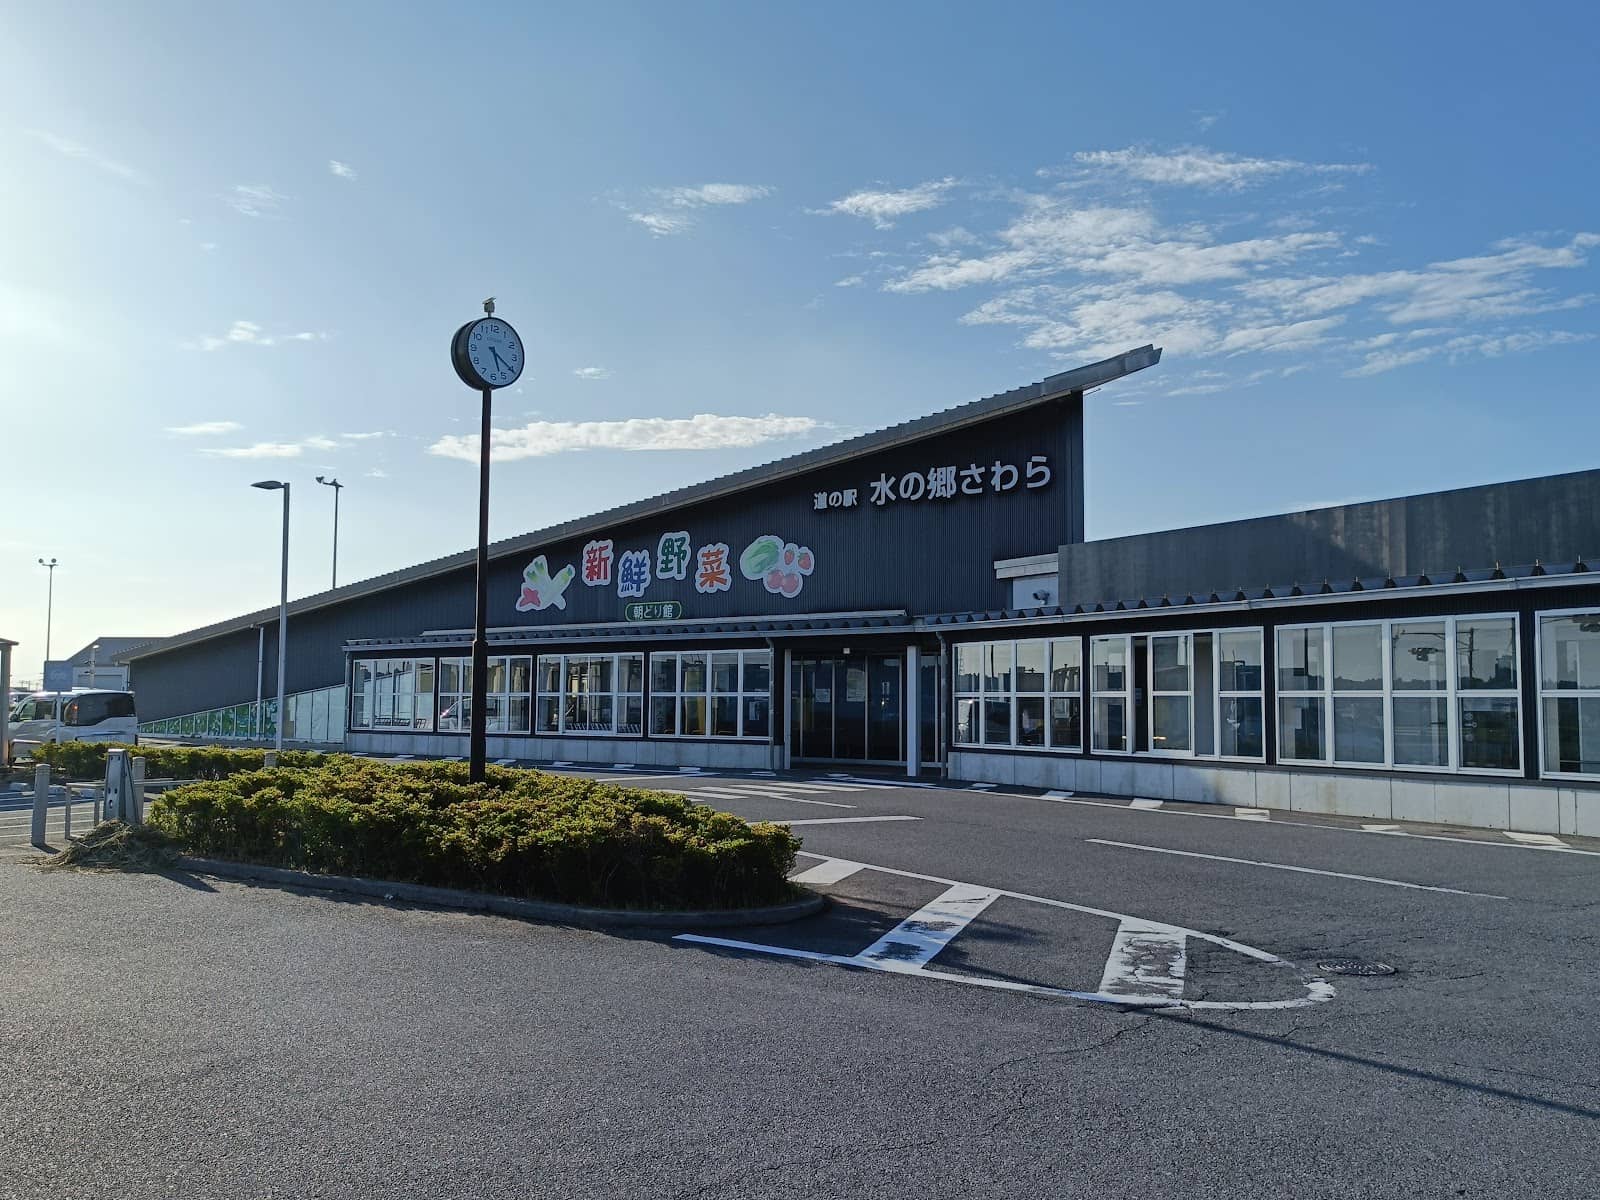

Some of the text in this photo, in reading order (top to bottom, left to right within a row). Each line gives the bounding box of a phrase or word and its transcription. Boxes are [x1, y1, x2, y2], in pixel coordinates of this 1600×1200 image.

[481, 325, 488, 333] 11
[490, 324, 500, 334] 12
[473, 332, 482, 340] 10
[508, 342, 515, 350] 2
[500, 372, 507, 380] 5
[813, 455, 1051, 510] 道の駅 水の郷さわら
[584, 534, 730, 594] 新鮮野菜
[632, 603, 674, 618] 朝どり館
